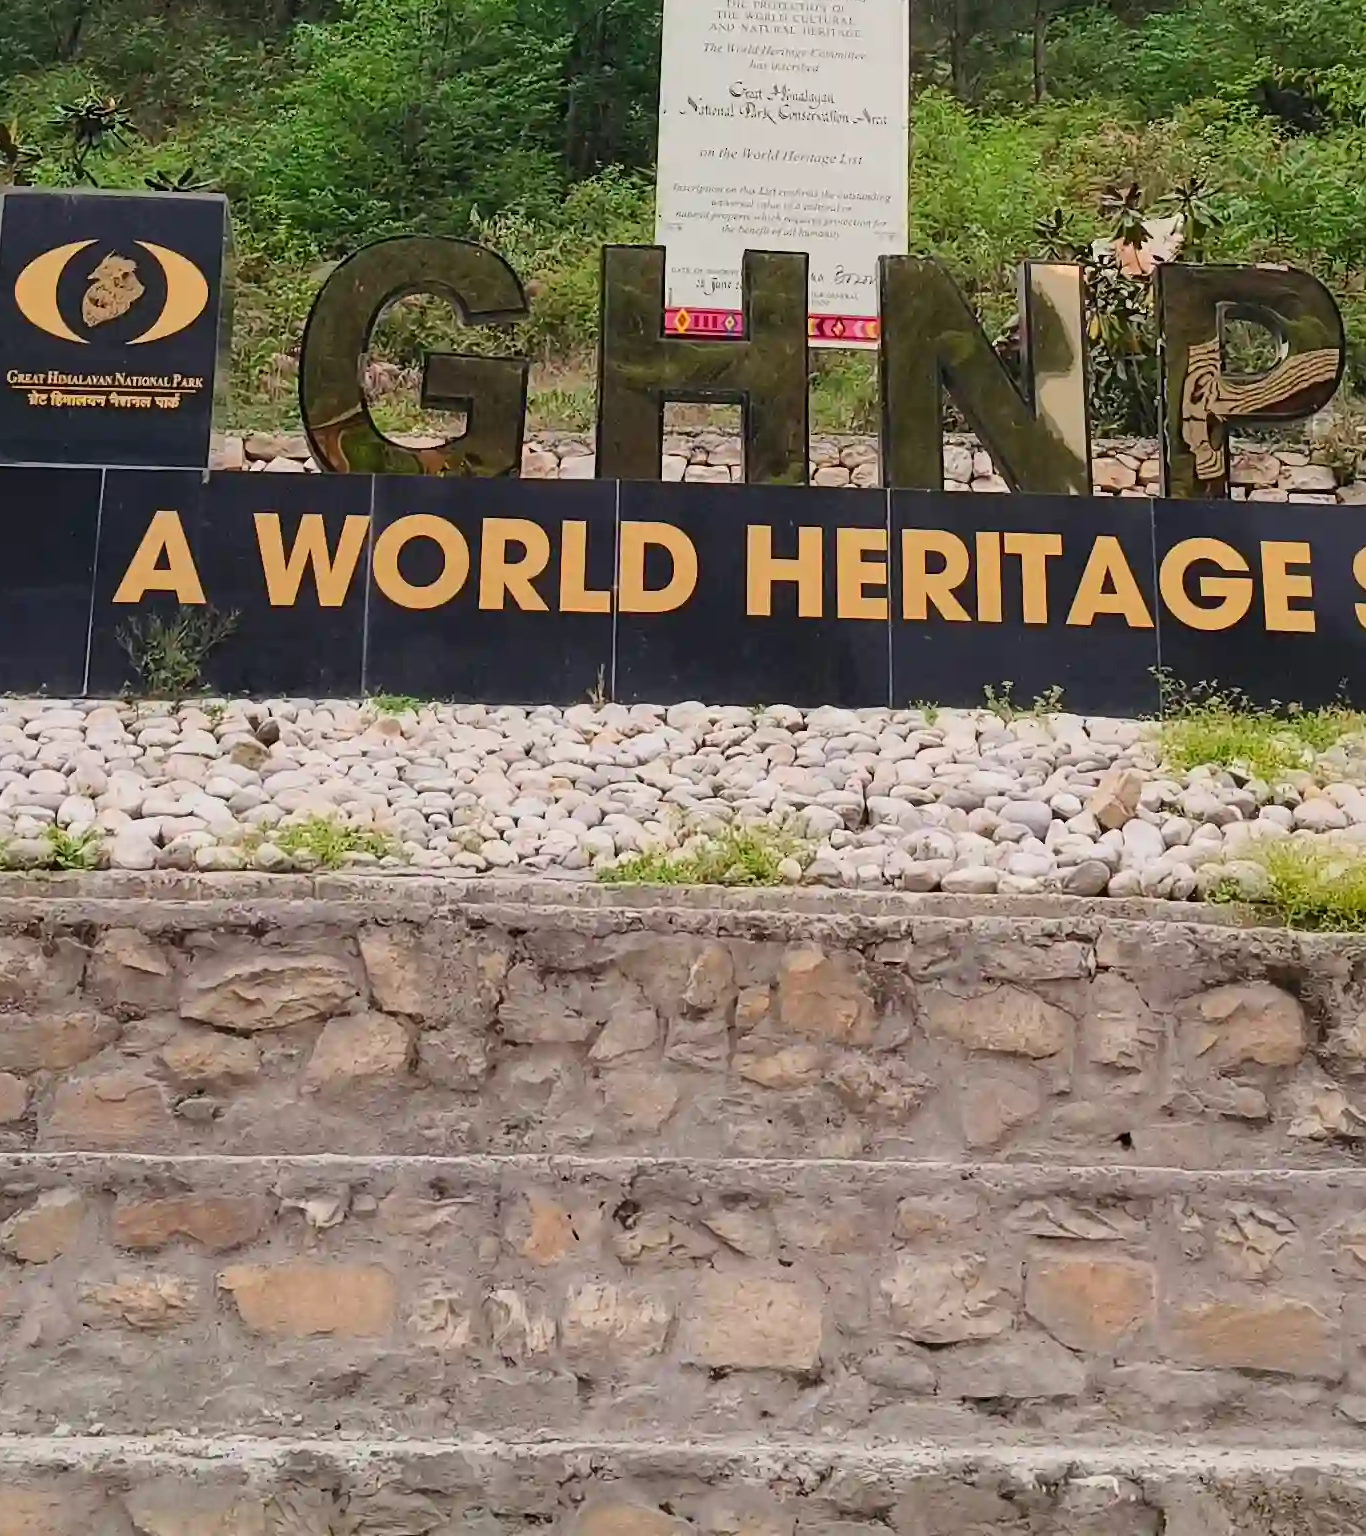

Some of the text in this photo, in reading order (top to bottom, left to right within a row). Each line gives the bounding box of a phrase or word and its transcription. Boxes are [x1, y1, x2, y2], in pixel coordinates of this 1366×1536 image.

[792, 14, 855, 26] CULTURAL
[708, 23, 863, 38] AND NATURAL HERITAGE
[703, 42, 723, 53] The
[727, 43, 757, 55] World
[728, 81, 835, 109] Great Himalayan
[679, 96, 735, 117] National
[739, 101, 778, 125] Park
[778, 104, 850, 124] Conservation
[699, 147, 863, 168] on the World Heritage List
[299, 234, 1344, 499] GHNP
[6, 369, 203, 388] GREAT HIMALAYAN NATIONAL PARK
[50, 391, 106, 407] हिमालयन
[155, 393, 182, 409] पार्क
[112, 510, 207, 605] A
[254, 512, 698, 614] WORLD
[746, 524, 1316, 633] HERITAGE
